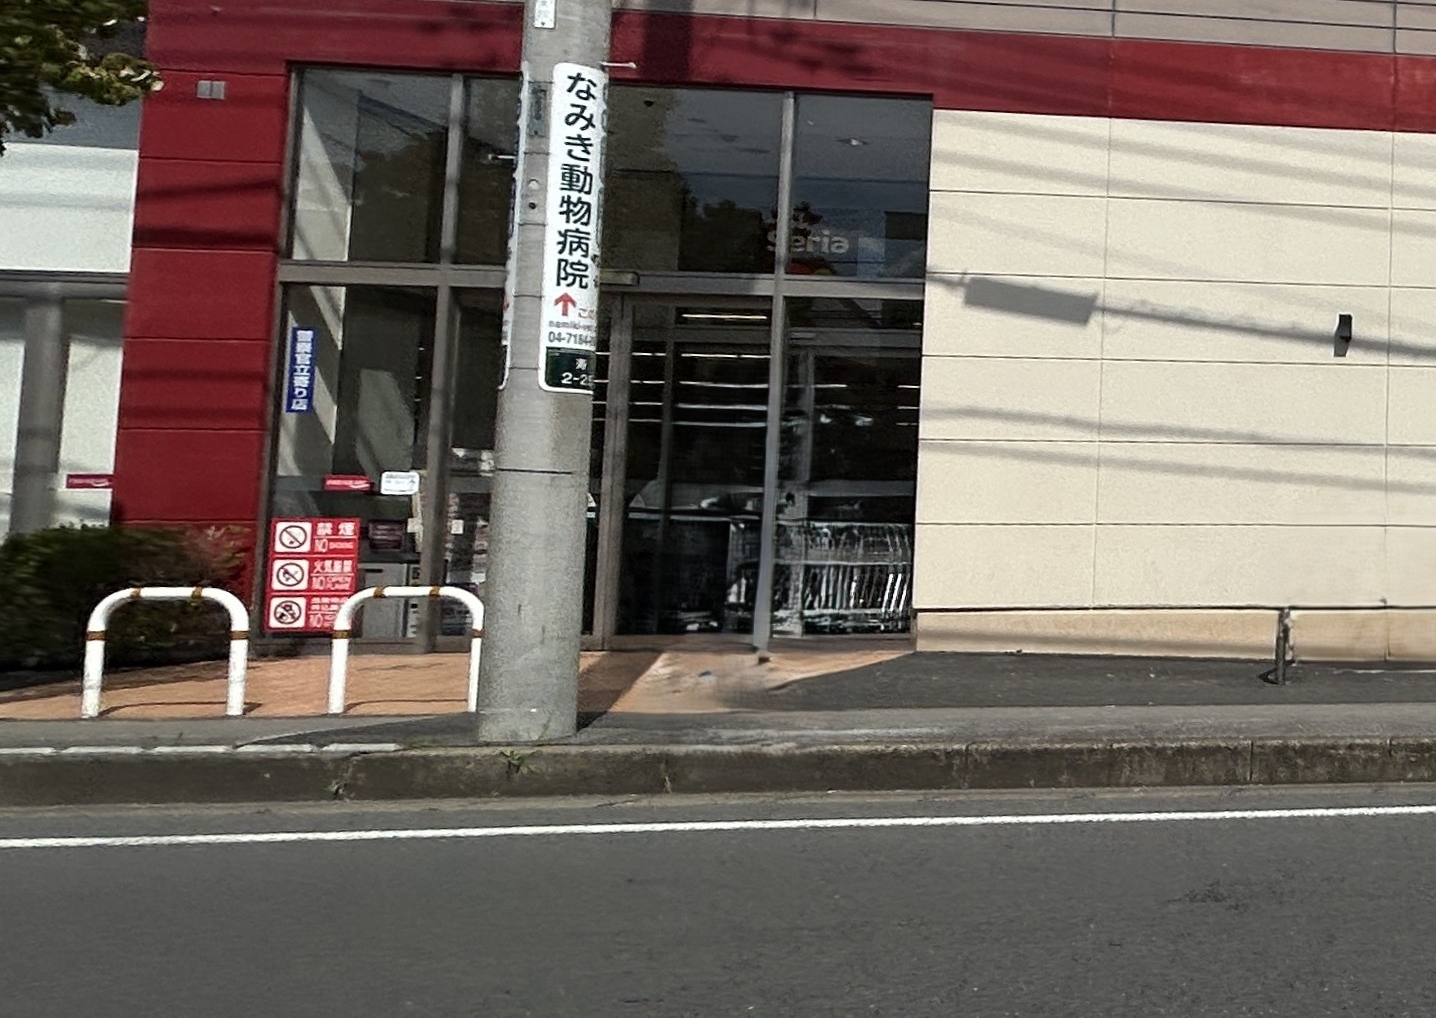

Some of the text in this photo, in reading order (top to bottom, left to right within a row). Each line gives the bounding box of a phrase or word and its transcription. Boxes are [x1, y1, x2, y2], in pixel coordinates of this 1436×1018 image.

[556, 72, 598, 290] なみき動物病院
